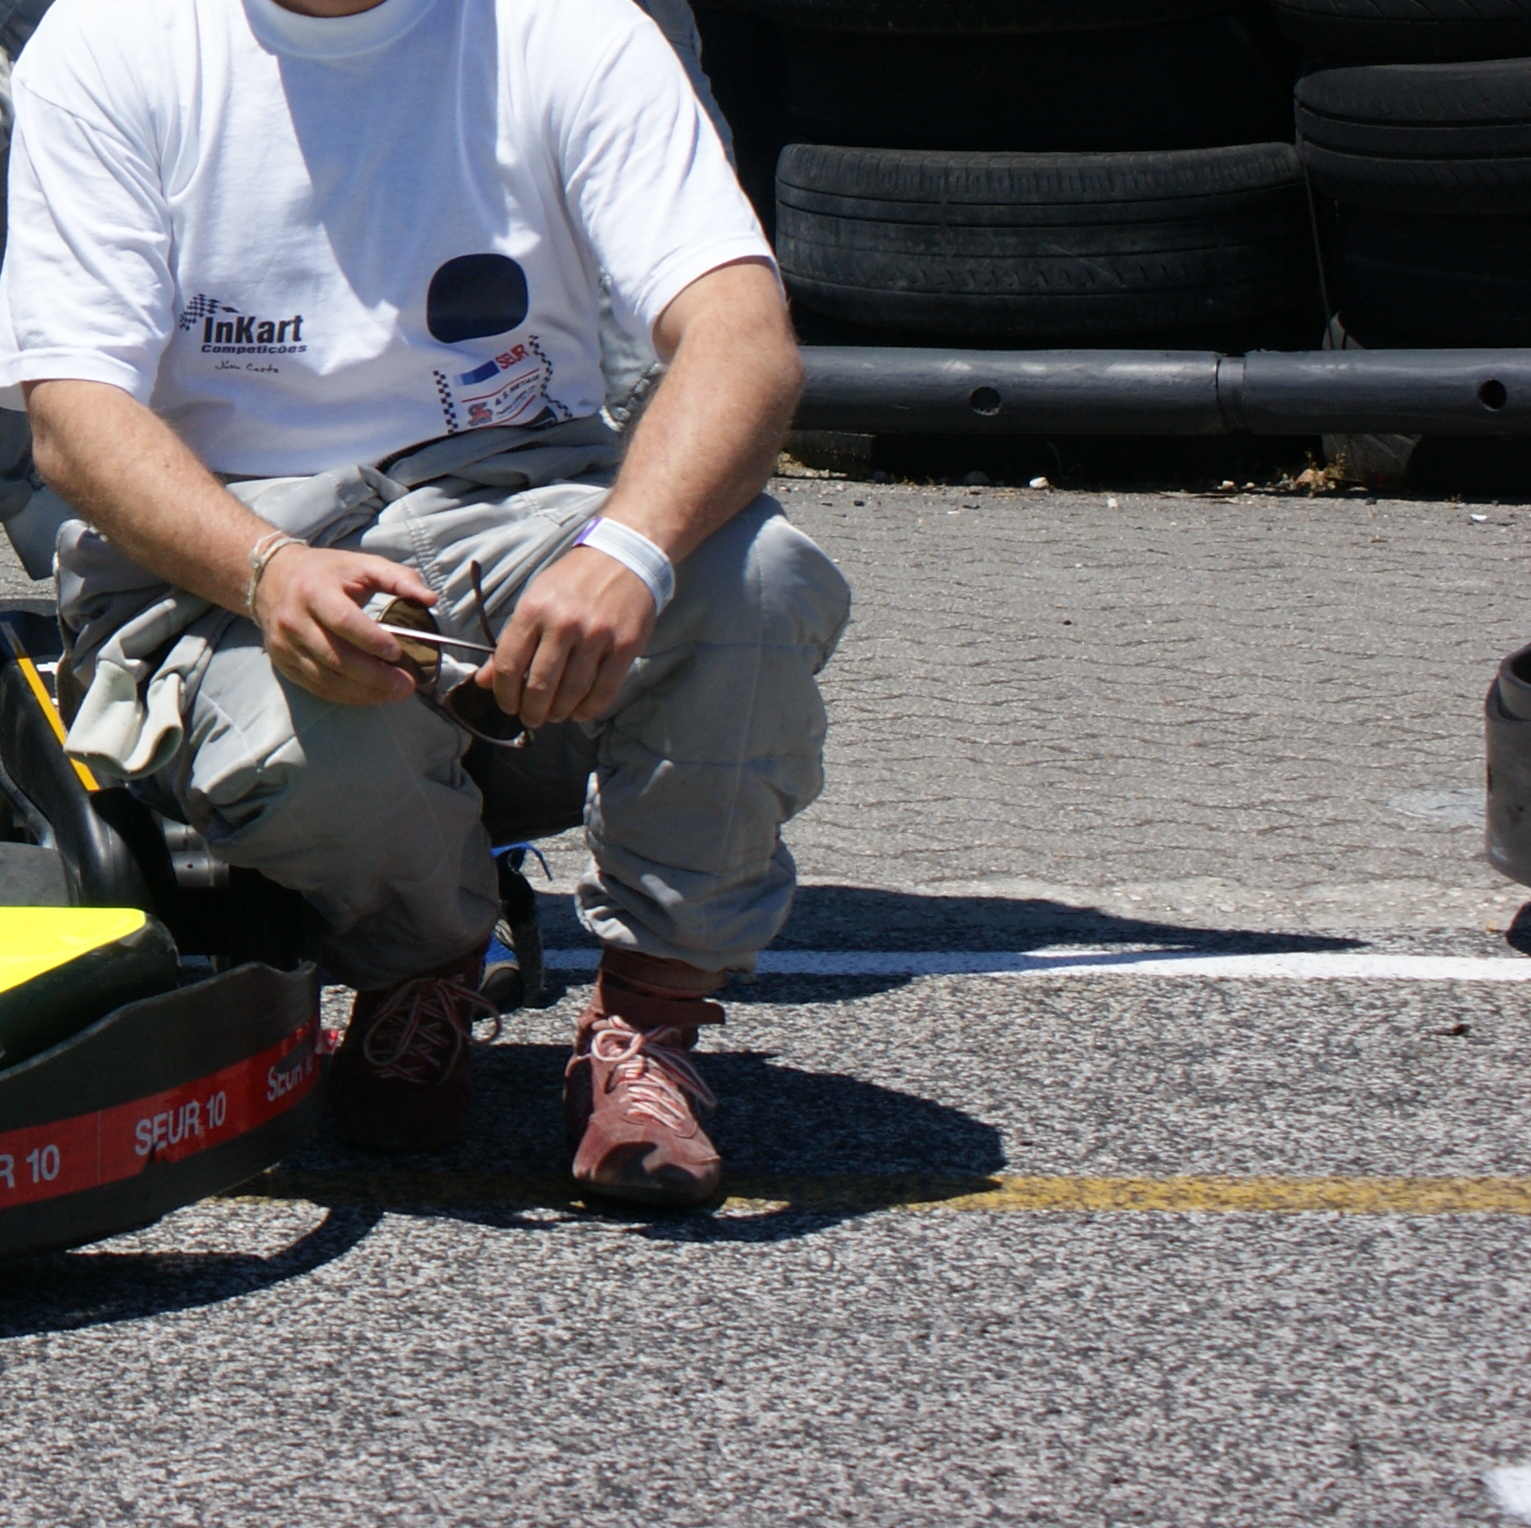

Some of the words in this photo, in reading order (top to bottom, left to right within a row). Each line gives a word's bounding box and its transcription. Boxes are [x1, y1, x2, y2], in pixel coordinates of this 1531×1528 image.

[204, 315, 303, 344] InKart
[495, 344, 530, 370] SEUR
[135, 1099, 200, 1158] SEUR
[207, 1091, 227, 1130] 10
[27, 1145, 60, 1185] 10
